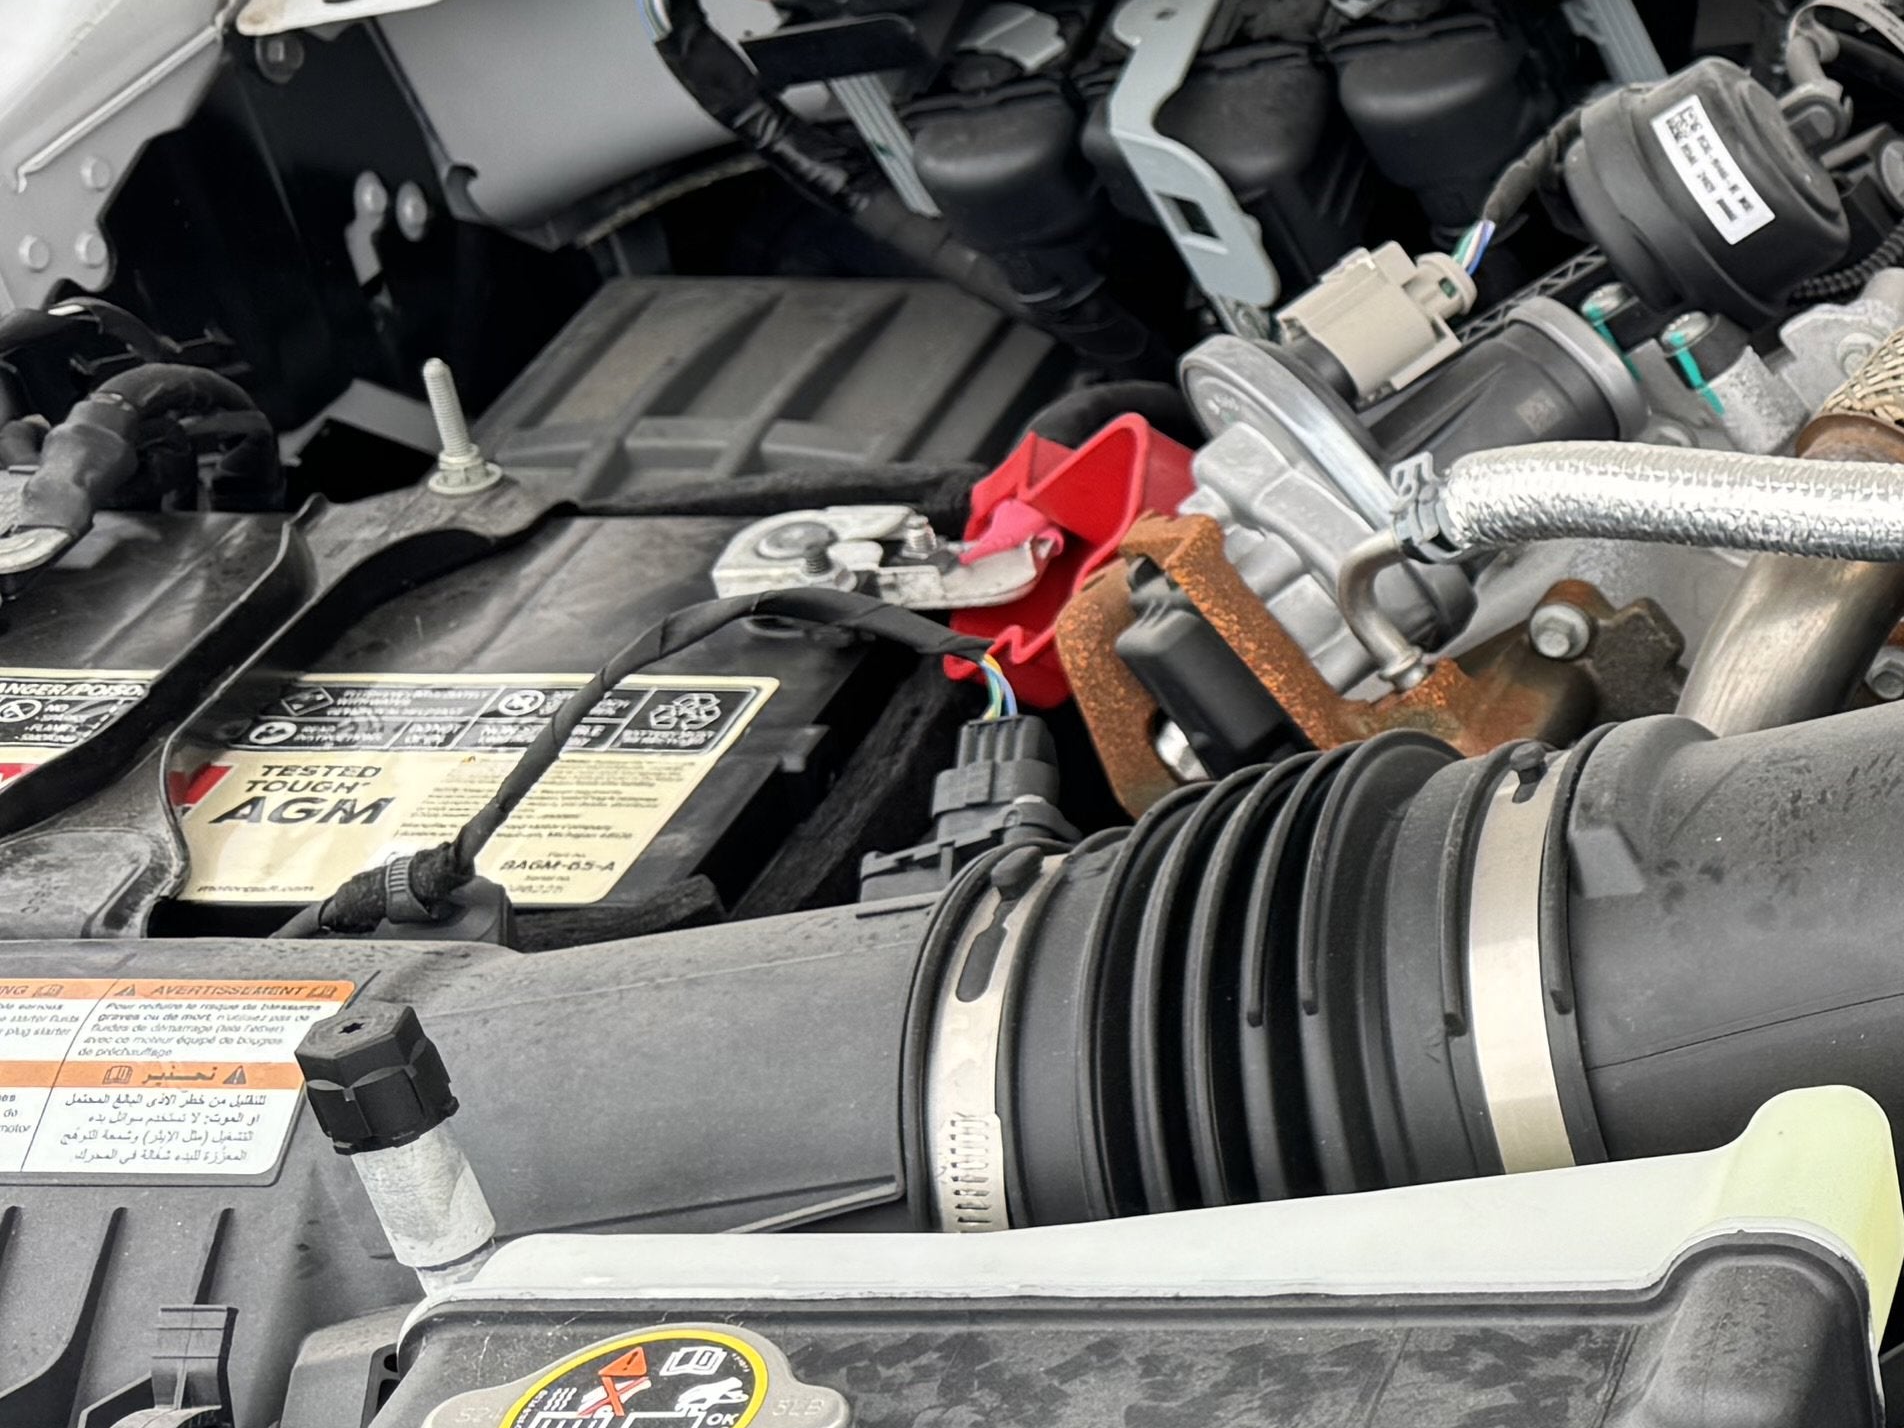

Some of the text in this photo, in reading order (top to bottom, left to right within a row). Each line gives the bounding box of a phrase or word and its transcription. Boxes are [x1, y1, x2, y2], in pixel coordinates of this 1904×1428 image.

[261, 764, 382, 778] TESTED
[207, 795, 396, 824] AGM
[151, 984, 308, 997] AVERTISSEMENT
[142, 1064, 217, 1086] تحذير
[706, 1413, 737, 1426] OK
